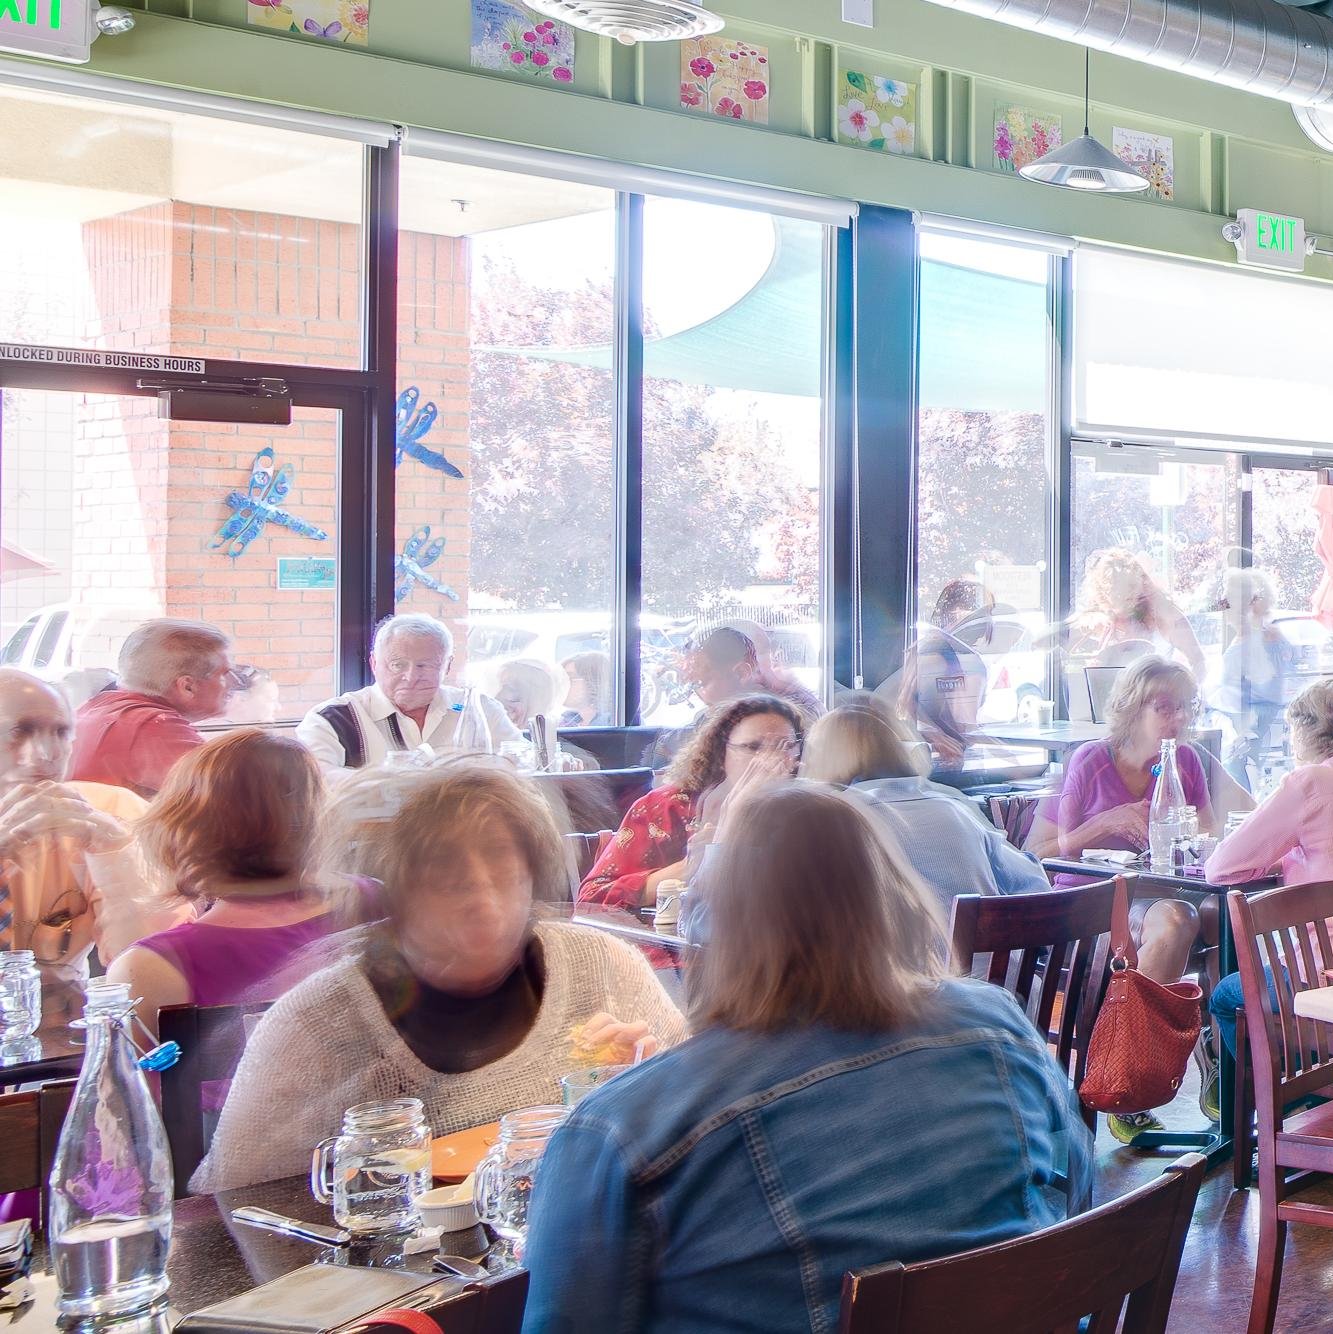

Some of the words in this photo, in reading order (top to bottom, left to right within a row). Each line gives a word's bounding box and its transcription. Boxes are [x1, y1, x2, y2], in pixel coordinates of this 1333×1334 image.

[1257, 213, 1297, 255] EXIT
[57, 350, 101, 365] DURING
[105, 354, 160, 369] BUSINESS
[163, 359, 202, 373] HOURS
